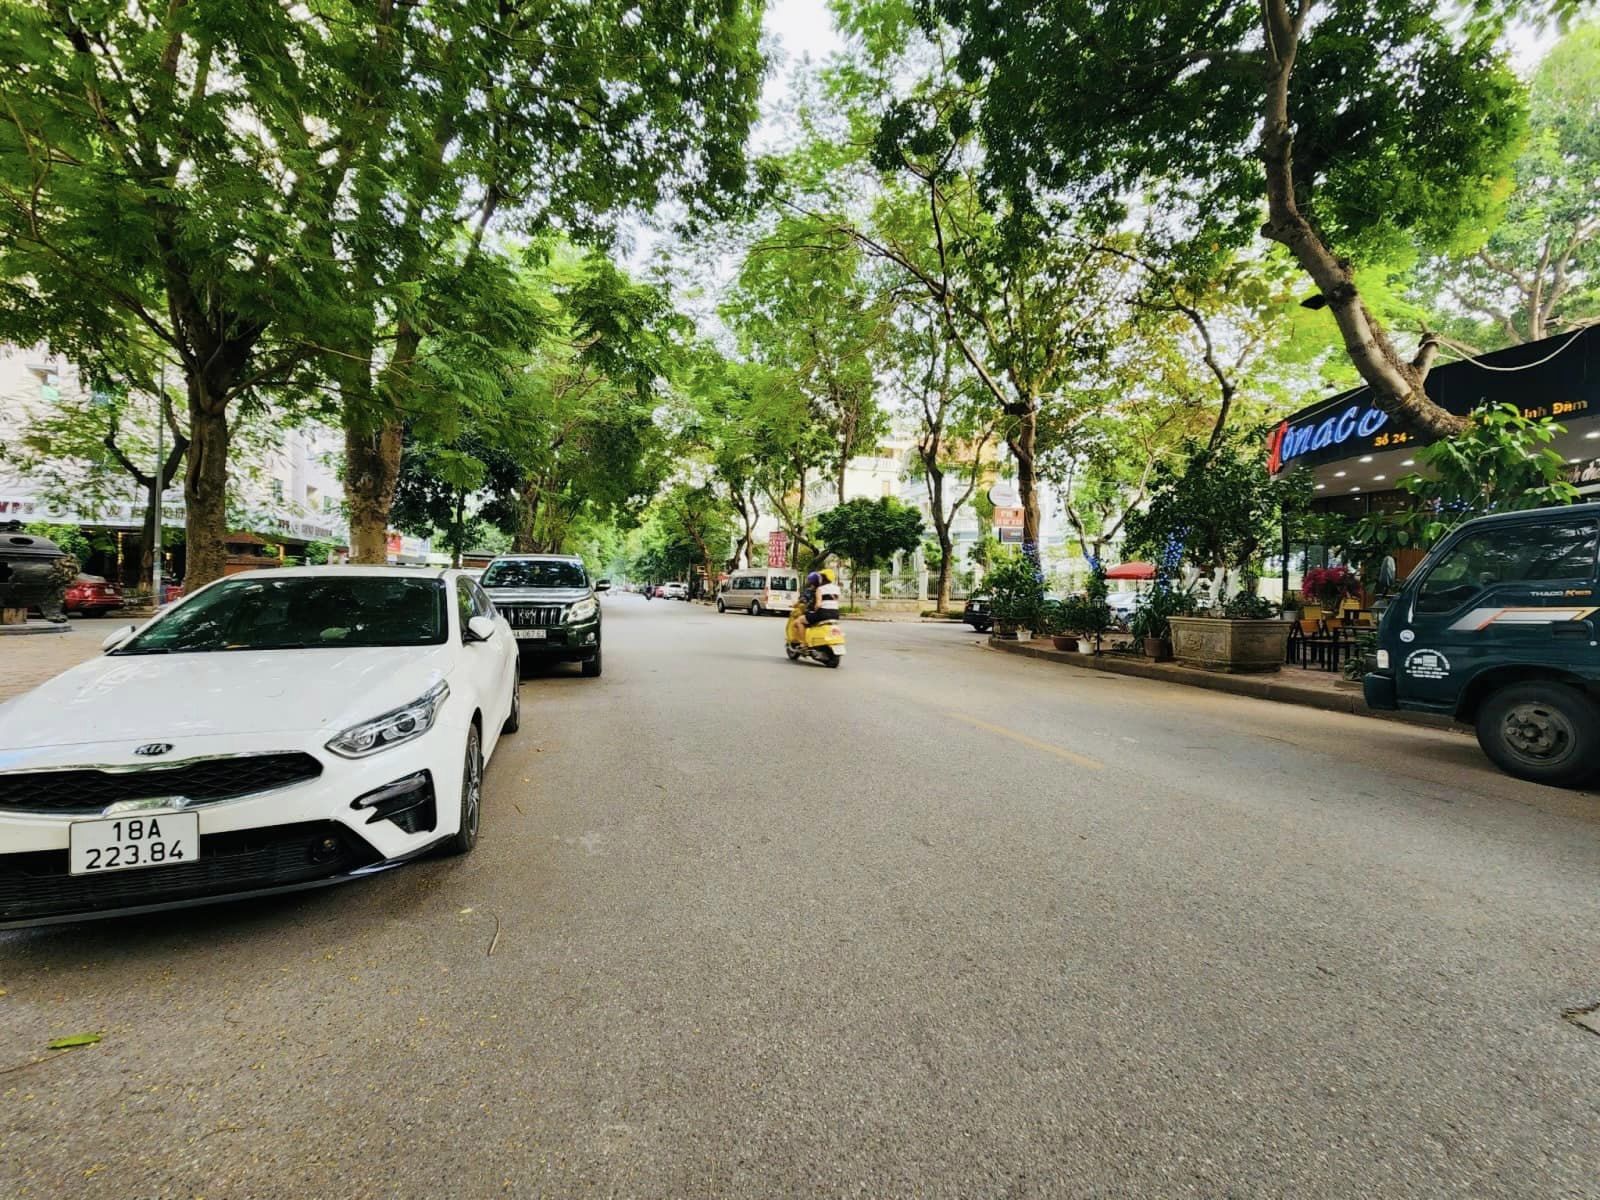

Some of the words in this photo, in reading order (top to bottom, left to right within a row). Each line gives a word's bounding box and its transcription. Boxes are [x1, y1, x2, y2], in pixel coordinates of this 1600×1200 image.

[135, 743, 171, 756] KIA
[112, 818, 162, 842] 18A
[85, 839, 184, 870] 223.84
